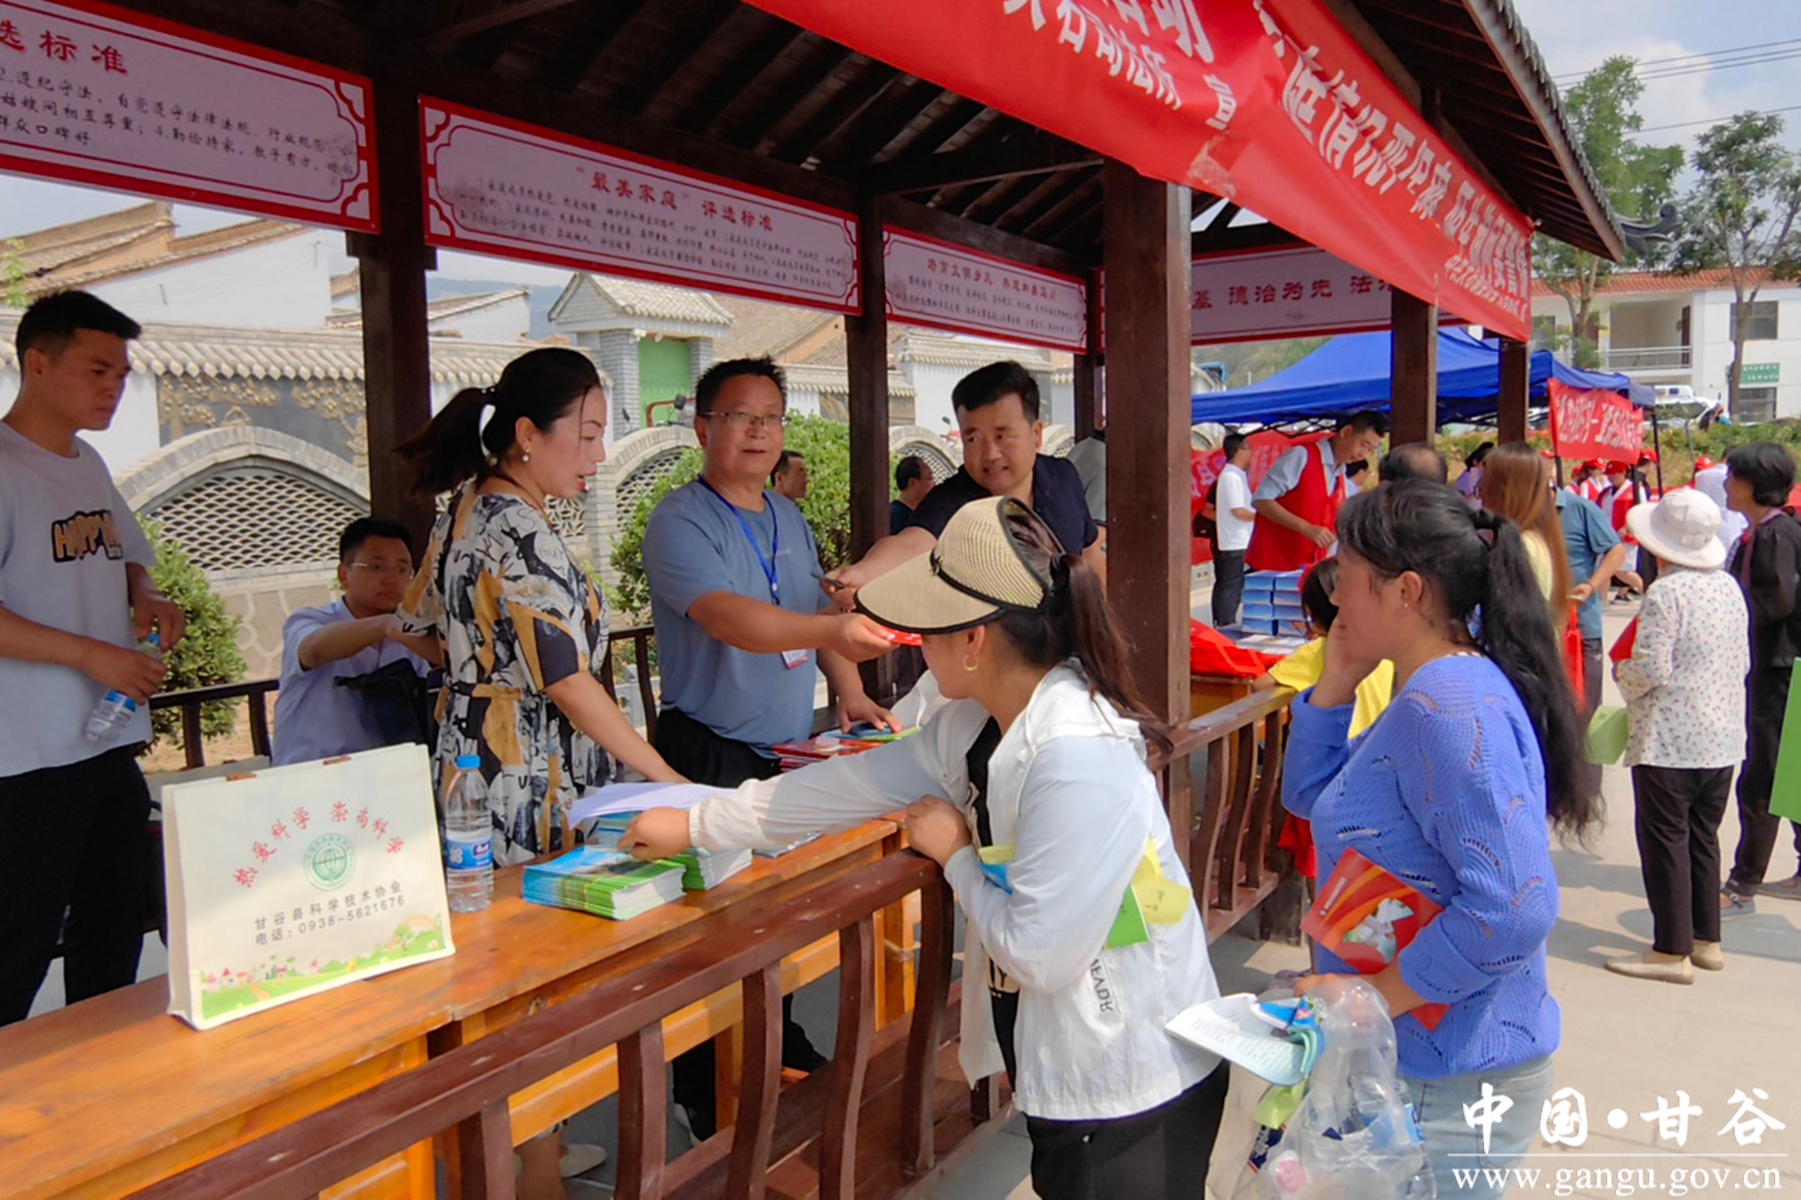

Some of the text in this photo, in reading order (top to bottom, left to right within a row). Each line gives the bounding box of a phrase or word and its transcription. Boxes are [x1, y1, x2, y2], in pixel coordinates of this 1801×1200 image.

[0, 20, 127, 75] 选标准
[1228, 279, 1333, 305] 德治为先
[254, 881, 402, 931] 甘谷县科学技术协会
